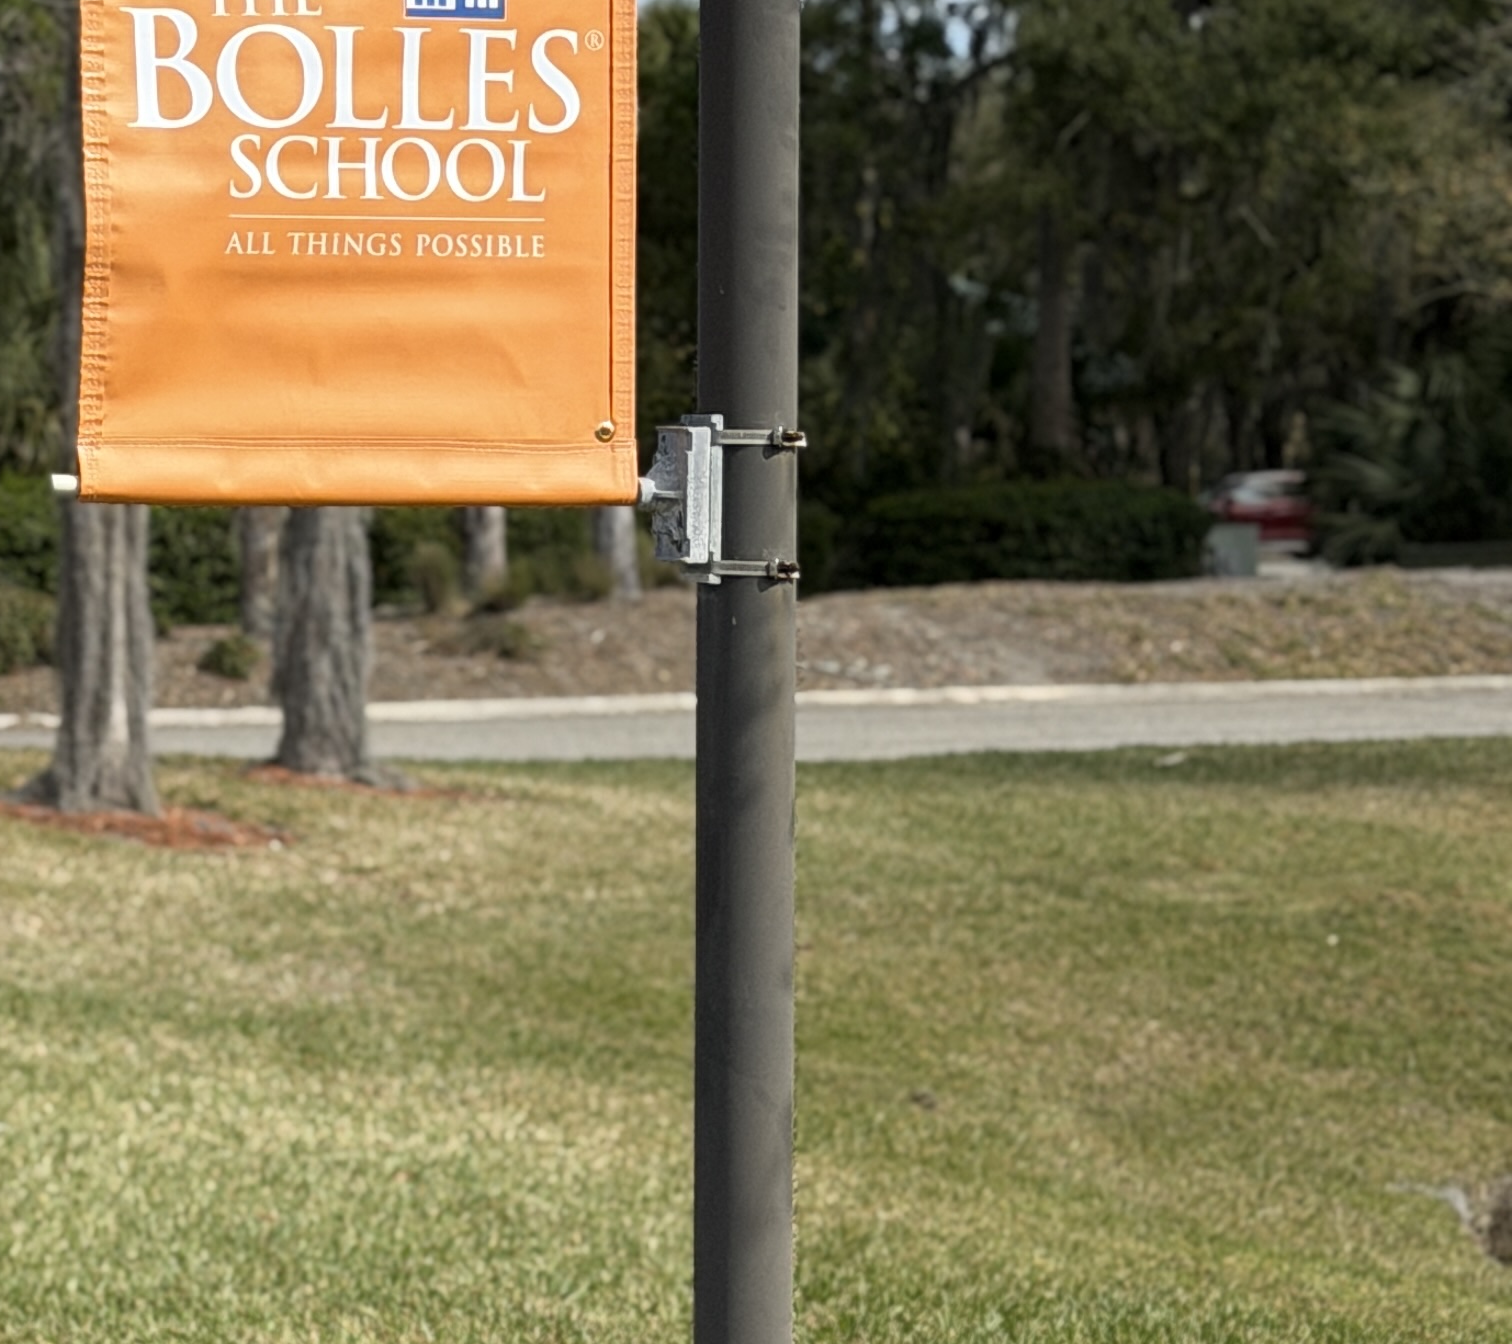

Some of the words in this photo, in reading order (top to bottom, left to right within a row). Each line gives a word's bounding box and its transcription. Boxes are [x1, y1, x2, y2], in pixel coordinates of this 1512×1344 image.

[228, 132, 546, 203] SCHOOL
[224, 232, 274, 256] ALL
[288, 232, 402, 257] THINGS
[416, 233, 546, 258] POSSIBLE
